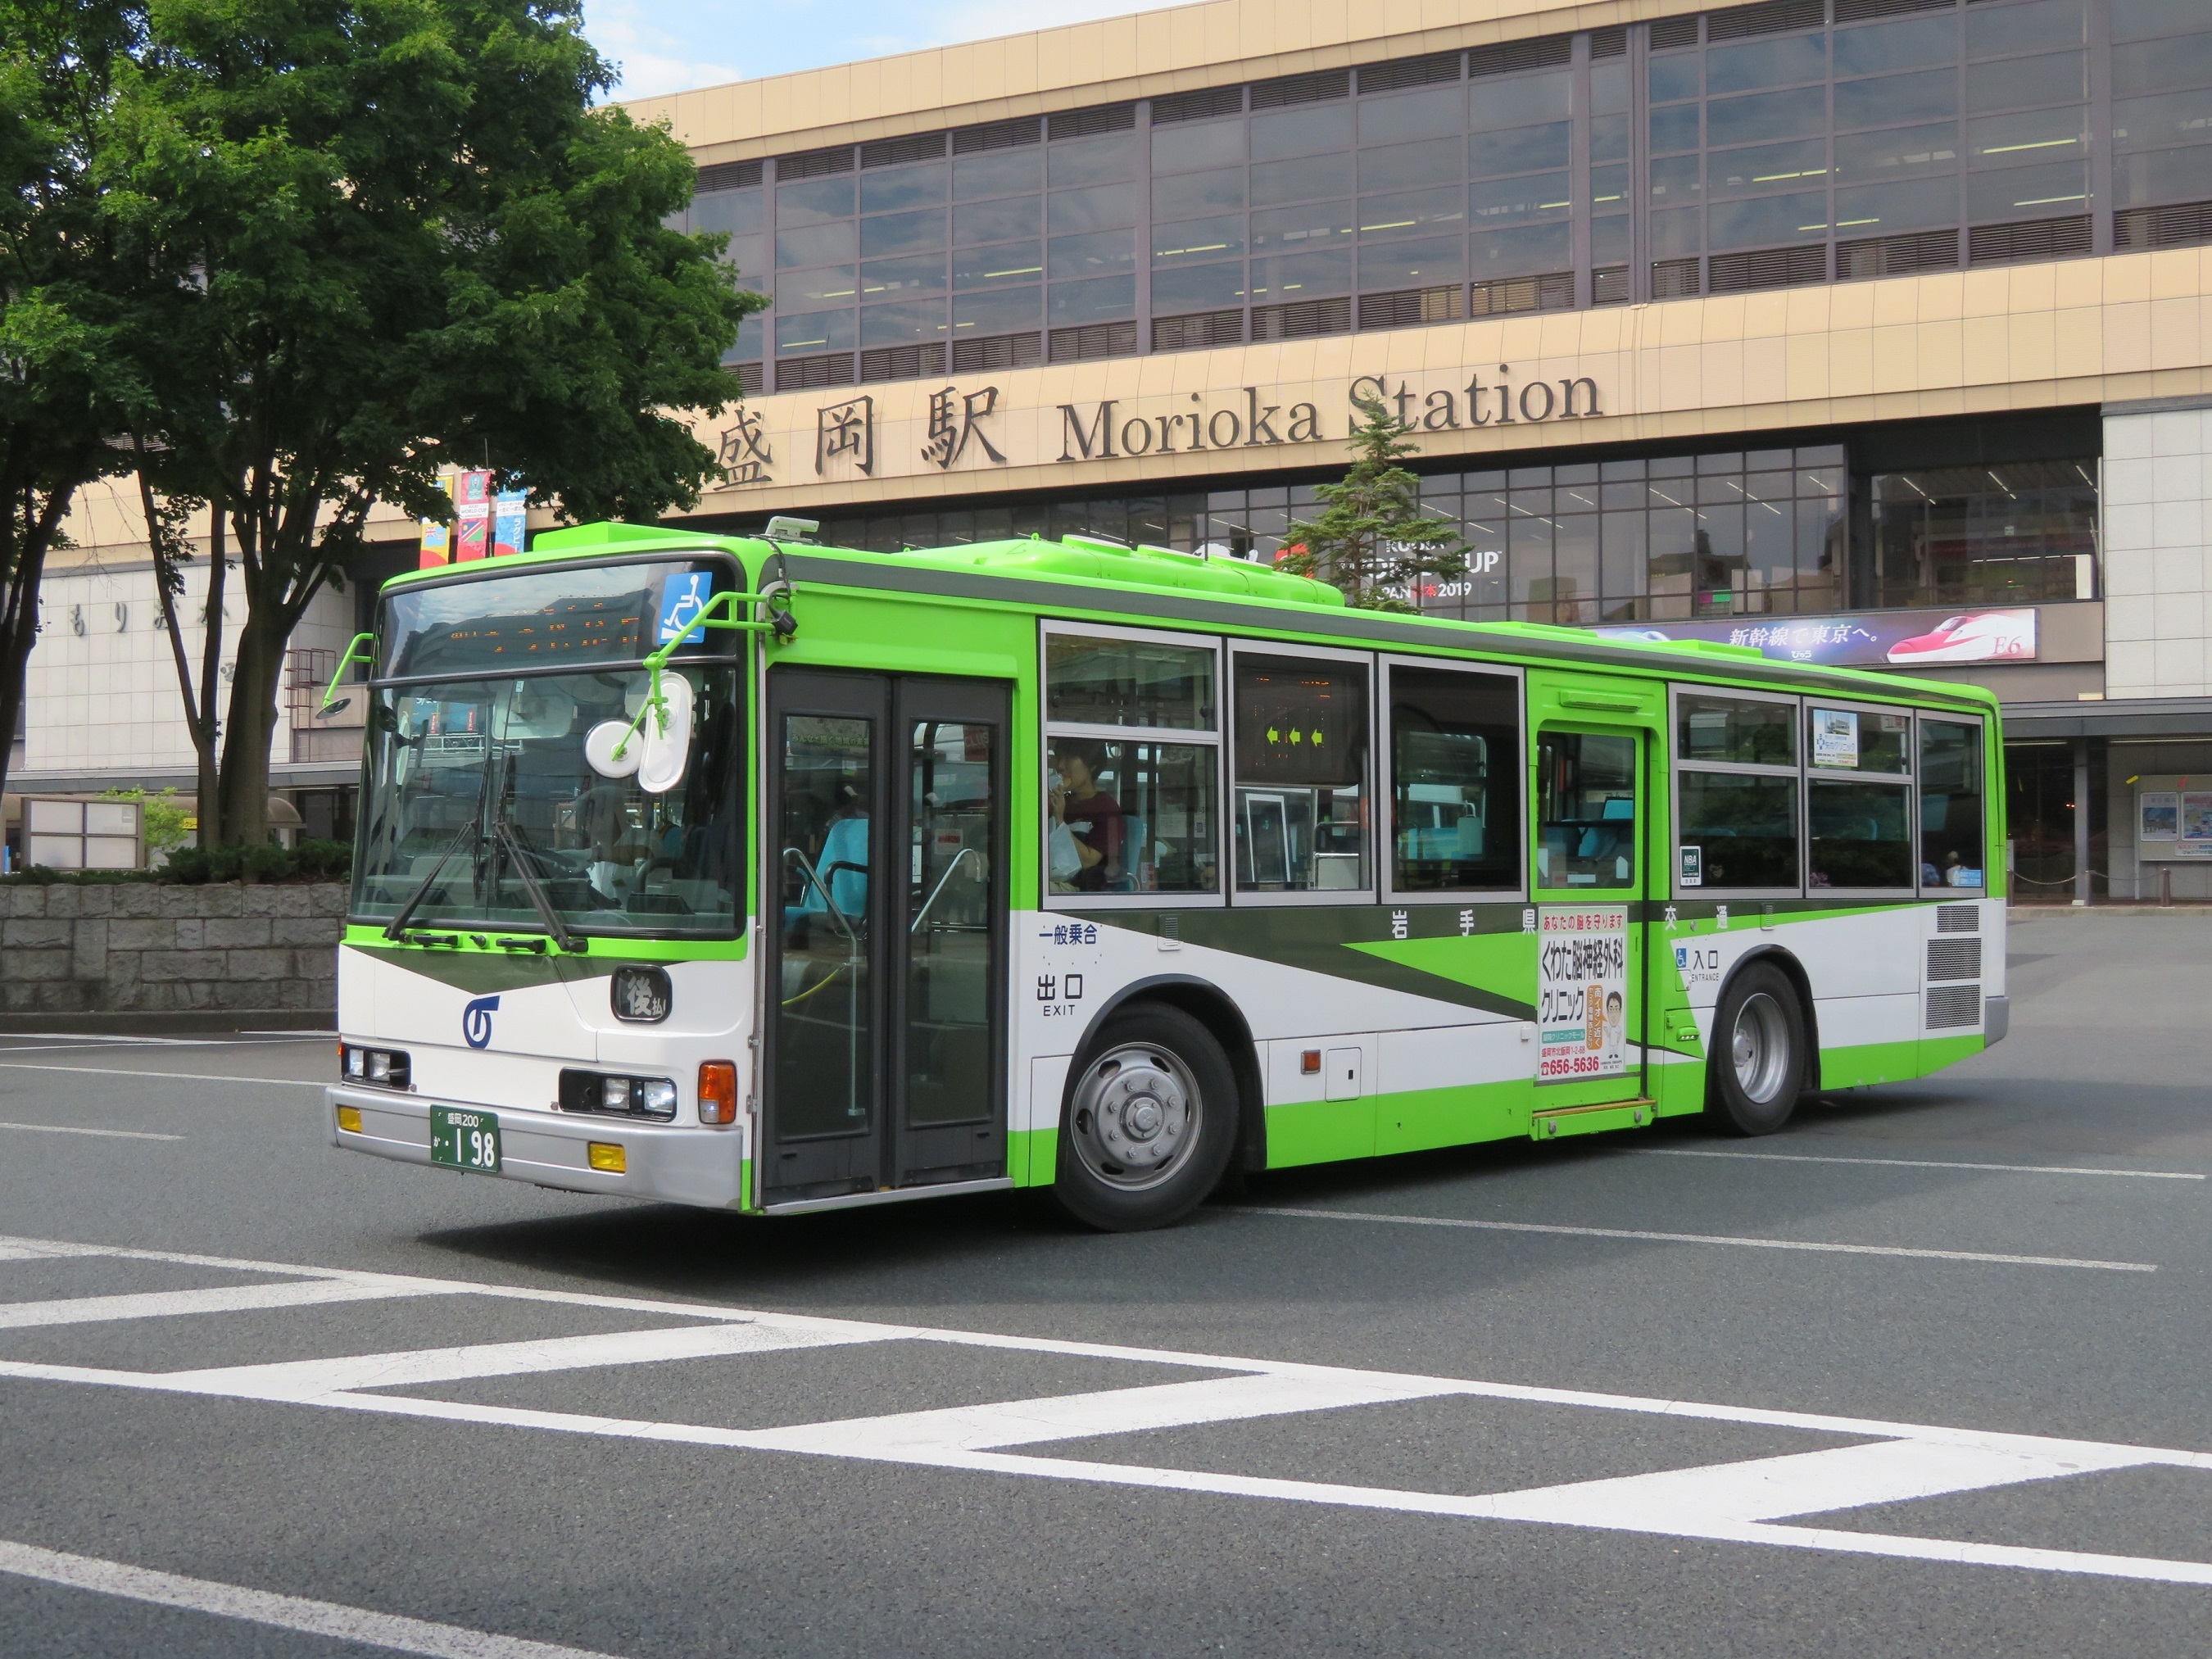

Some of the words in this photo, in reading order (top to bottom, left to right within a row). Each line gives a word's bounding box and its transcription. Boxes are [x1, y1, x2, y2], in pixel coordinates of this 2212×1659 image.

[1056, 387, 1323, 462] Morioka
[1349, 364, 1603, 439] Station
[713, 386, 1007, 492] 盛岡駅
[1438, 582, 1472, 597] 2019
[1729, 623, 1877, 647] 新幹線で東京へ。
[1992, 635, 2022, 655] E6
[1684, 854, 1697, 864] NBA
[1543, 913, 1623, 931] あなたの脳を守ります
[1039, 923, 1097, 945] 一般乗合
[1542, 937, 1624, 981] くわた脳神経外科
[1693, 950, 1719, 970] 入口
[1037, 973, 1083, 1000] 出口
[1691, 972, 1720, 983] ENTRANCE
[1044, 1004, 1076, 1017] EXIT
[1541, 986, 1584, 1024] クリニック
[1594, 987, 1602, 1048] 南イオン近く
[1550, 1055, 1599, 1075] 656-5636
[433, 1135, 441, 1148] か
